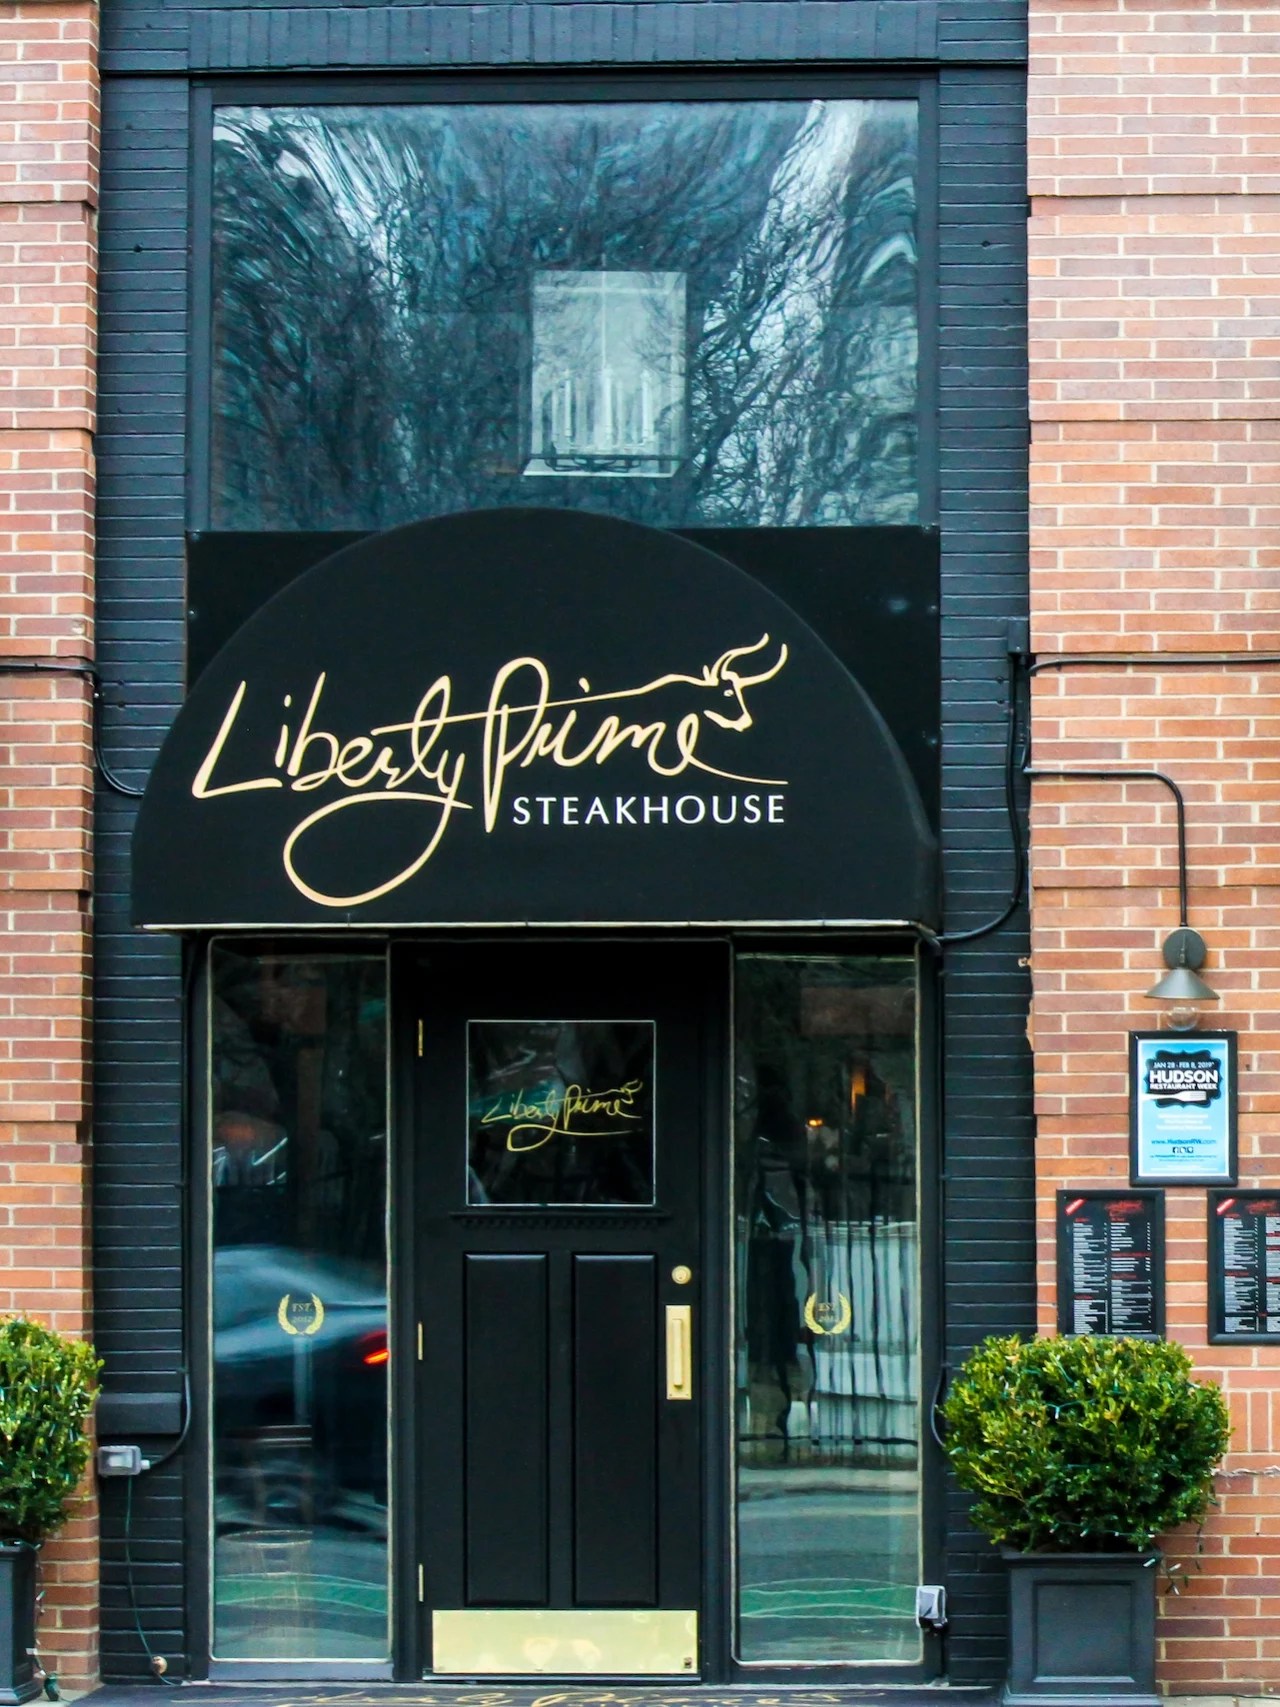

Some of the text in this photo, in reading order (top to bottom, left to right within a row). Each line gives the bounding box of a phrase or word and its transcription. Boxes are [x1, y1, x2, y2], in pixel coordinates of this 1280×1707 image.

[192, 655, 789, 908] Liberty Prime
[512, 794, 787, 826] STEAKHOUSE
[1149, 1070, 1219, 1083] HUDSON
